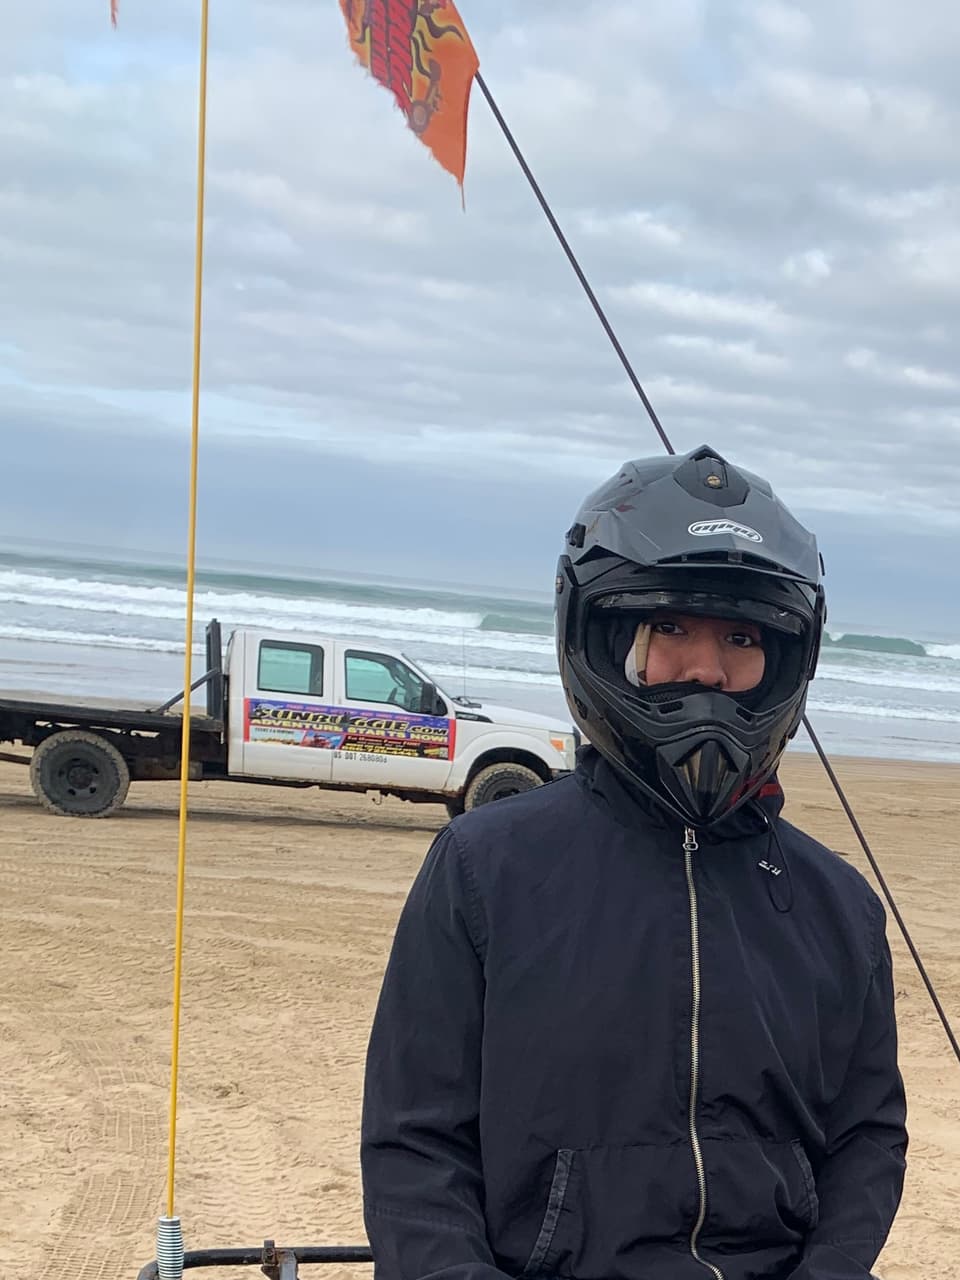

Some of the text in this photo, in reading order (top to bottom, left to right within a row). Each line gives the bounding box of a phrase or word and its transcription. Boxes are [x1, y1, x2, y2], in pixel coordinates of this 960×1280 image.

[251, 719, 343, 732] ADVENTURE
[347, 726, 406, 739] STARTS
[410, 733, 448, 743] NOW!
